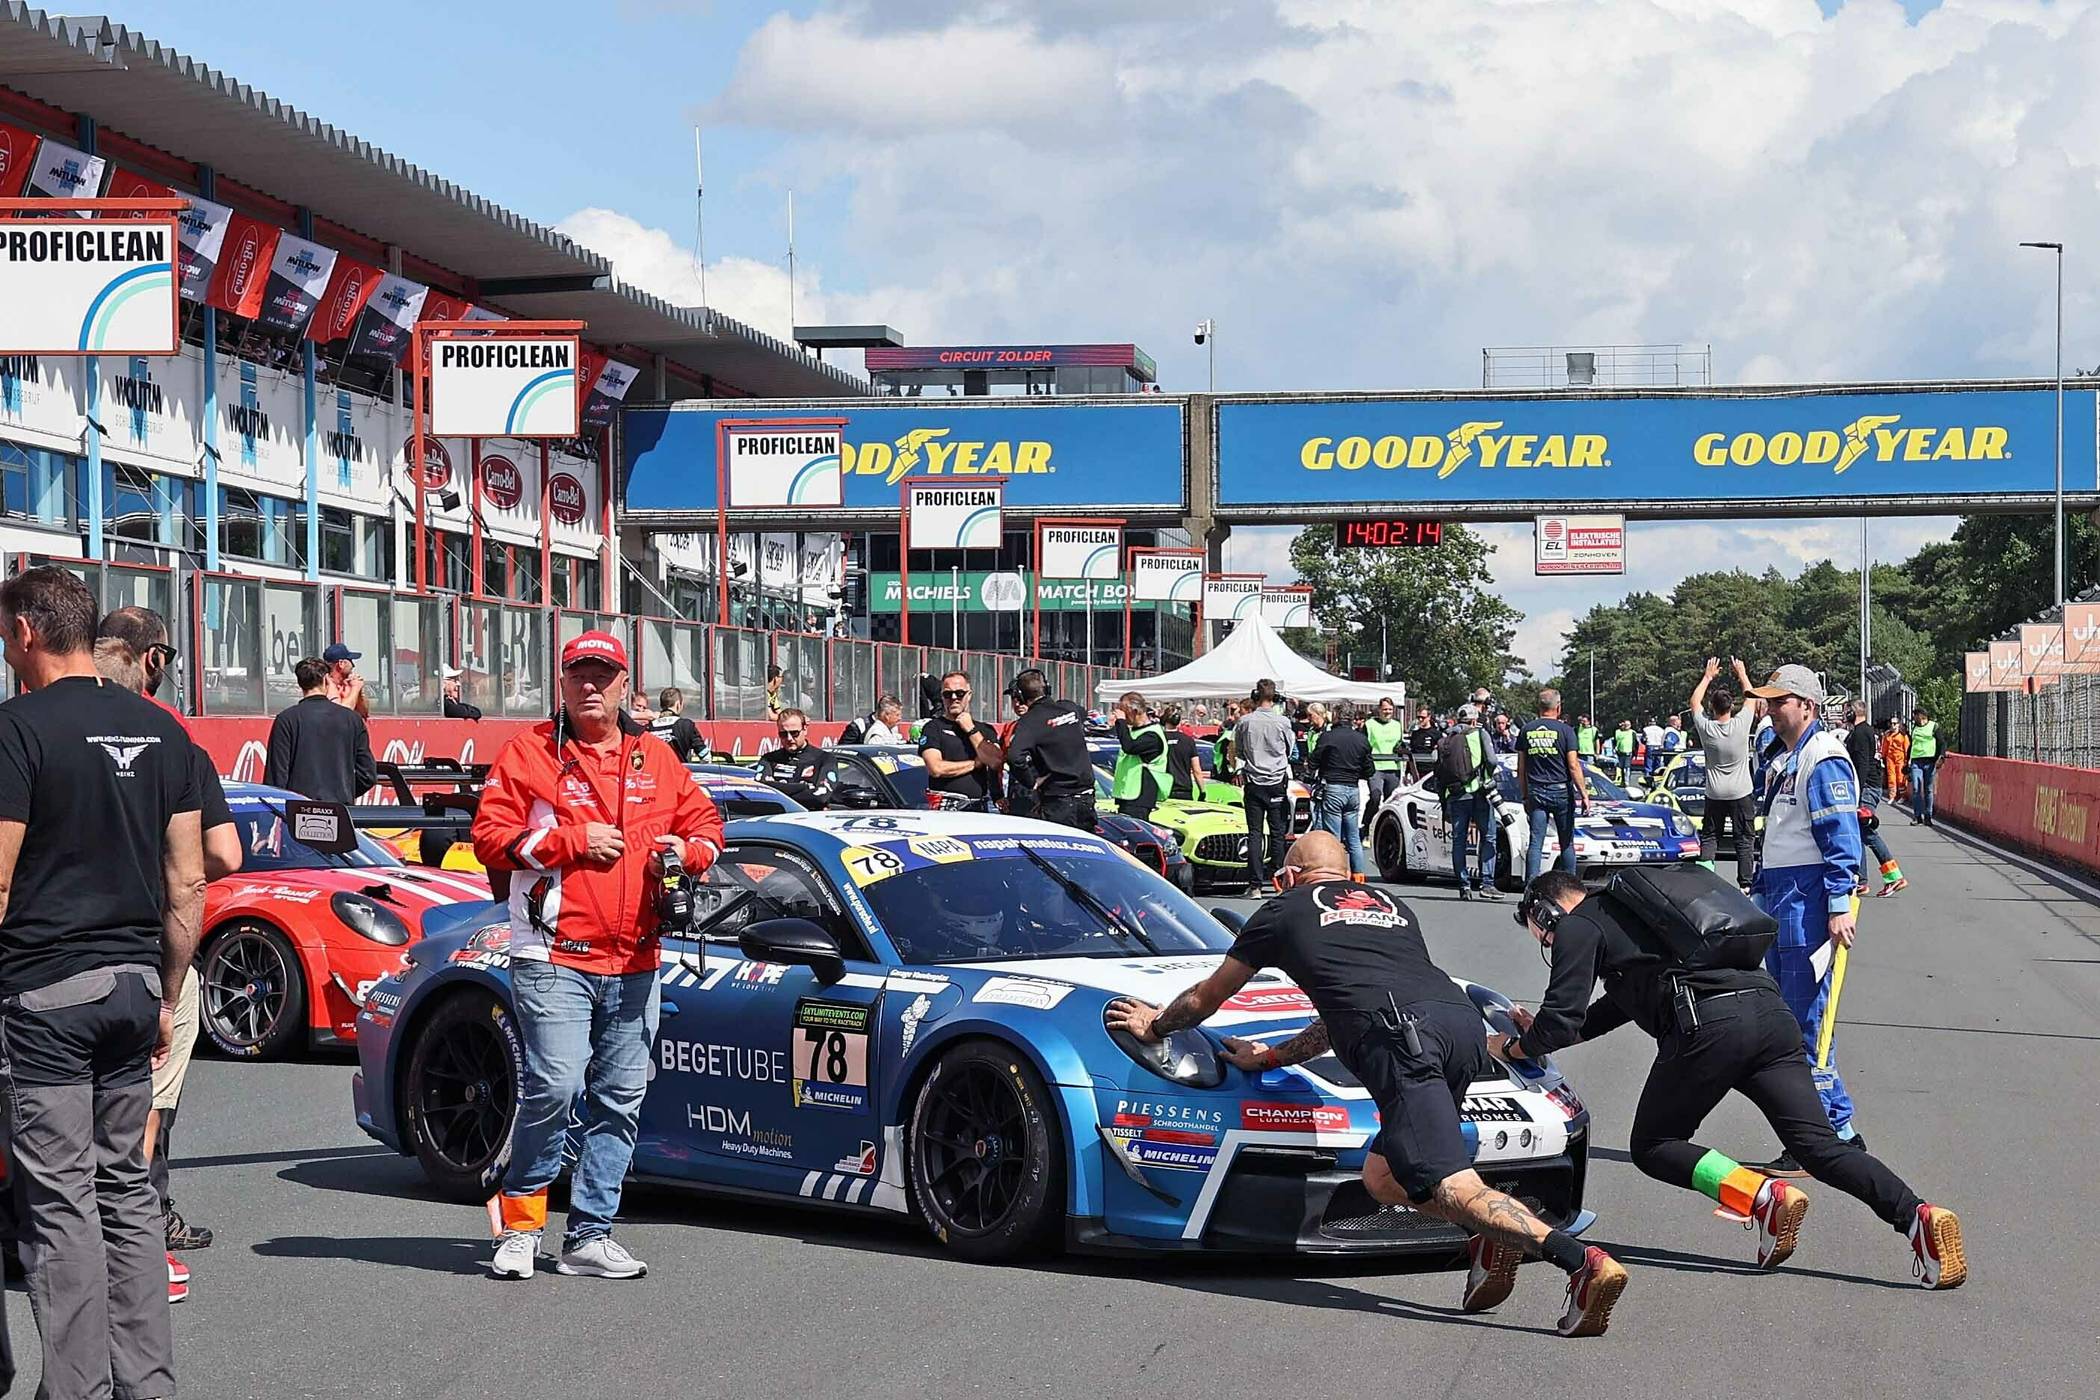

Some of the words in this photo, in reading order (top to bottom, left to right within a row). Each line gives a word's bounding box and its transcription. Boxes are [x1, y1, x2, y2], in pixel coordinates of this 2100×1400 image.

[441, 344, 570, 369] PROFICLEAN
[939, 351, 994, 363] CIRCUIT
[997, 350, 1053, 362] ZOLDER
[737, 436, 836, 456] PROFICLEAN
[915, 491, 996, 507] PROFICLEAN
[1048, 530, 1116, 545] PROFICLEAN
[1345, 522, 1441, 545] 14:02:14
[1545, 541, 1563, 551] EL
[1140, 557, 1200, 571] PROFICLEAN
[884, 585, 972, 601] MACHIELS
[1037, 584, 1098, 600] MATCH
[1207, 582, 1260, 593] PROFICLEAN
[1261, 593, 1307, 604] PROFICLEAN
[576, 639, 616, 652] MOTUL
[300, 806, 312, 814] THE
[312, 807, 334, 815] BRAXX
[835, 816, 899, 829] 78
[916, 839, 966, 857] NAPA
[851, 852, 900, 875] 78
[803, 1006, 865, 1021] SKYLIMITEVENTS.COM
[837, 1019, 863, 1027] RACETRACK
[660, 1038, 787, 1084] BEGETUBE
[804, 1028, 849, 1085] 78
[814, 1090, 862, 1105] MICHELIN
[1117, 1099, 1224, 1123] PIESSENS
[1245, 1107, 1345, 1121] CHAMPION
[686, 1102, 751, 1137] HDM
[1153, 1118, 1220, 1132] SCHROOTHANDEL
[1259, 1117, 1331, 1125] LUBRICANTS
[752, 1128, 793, 1147] motion
[1112, 1126, 1143, 1138] TISSELT
[721, 1139, 743, 1154] Heavy
[741, 1142, 760, 1155] Duty
[758, 1144, 793, 1160] Machines.
[1143, 1149, 1215, 1166] MICHELIN
